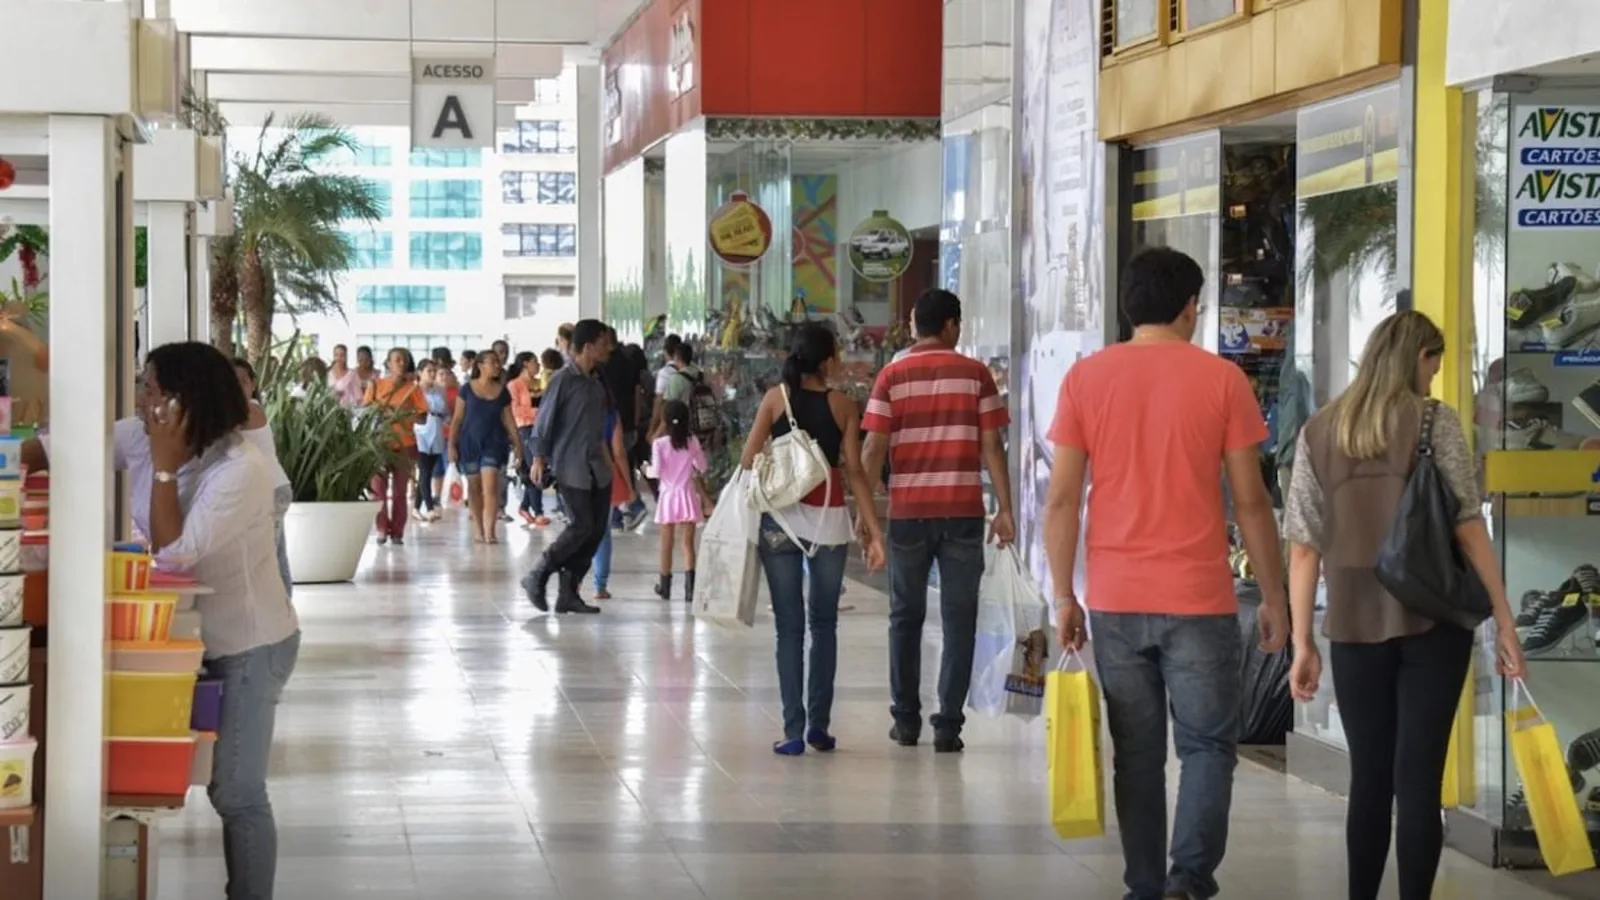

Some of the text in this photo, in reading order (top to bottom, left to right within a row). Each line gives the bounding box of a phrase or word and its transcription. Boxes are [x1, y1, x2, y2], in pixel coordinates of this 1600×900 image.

[422, 64, 484, 78] ACESSO
[431, 95, 473, 139] A
[1518, 107, 1600, 142] AVIST
